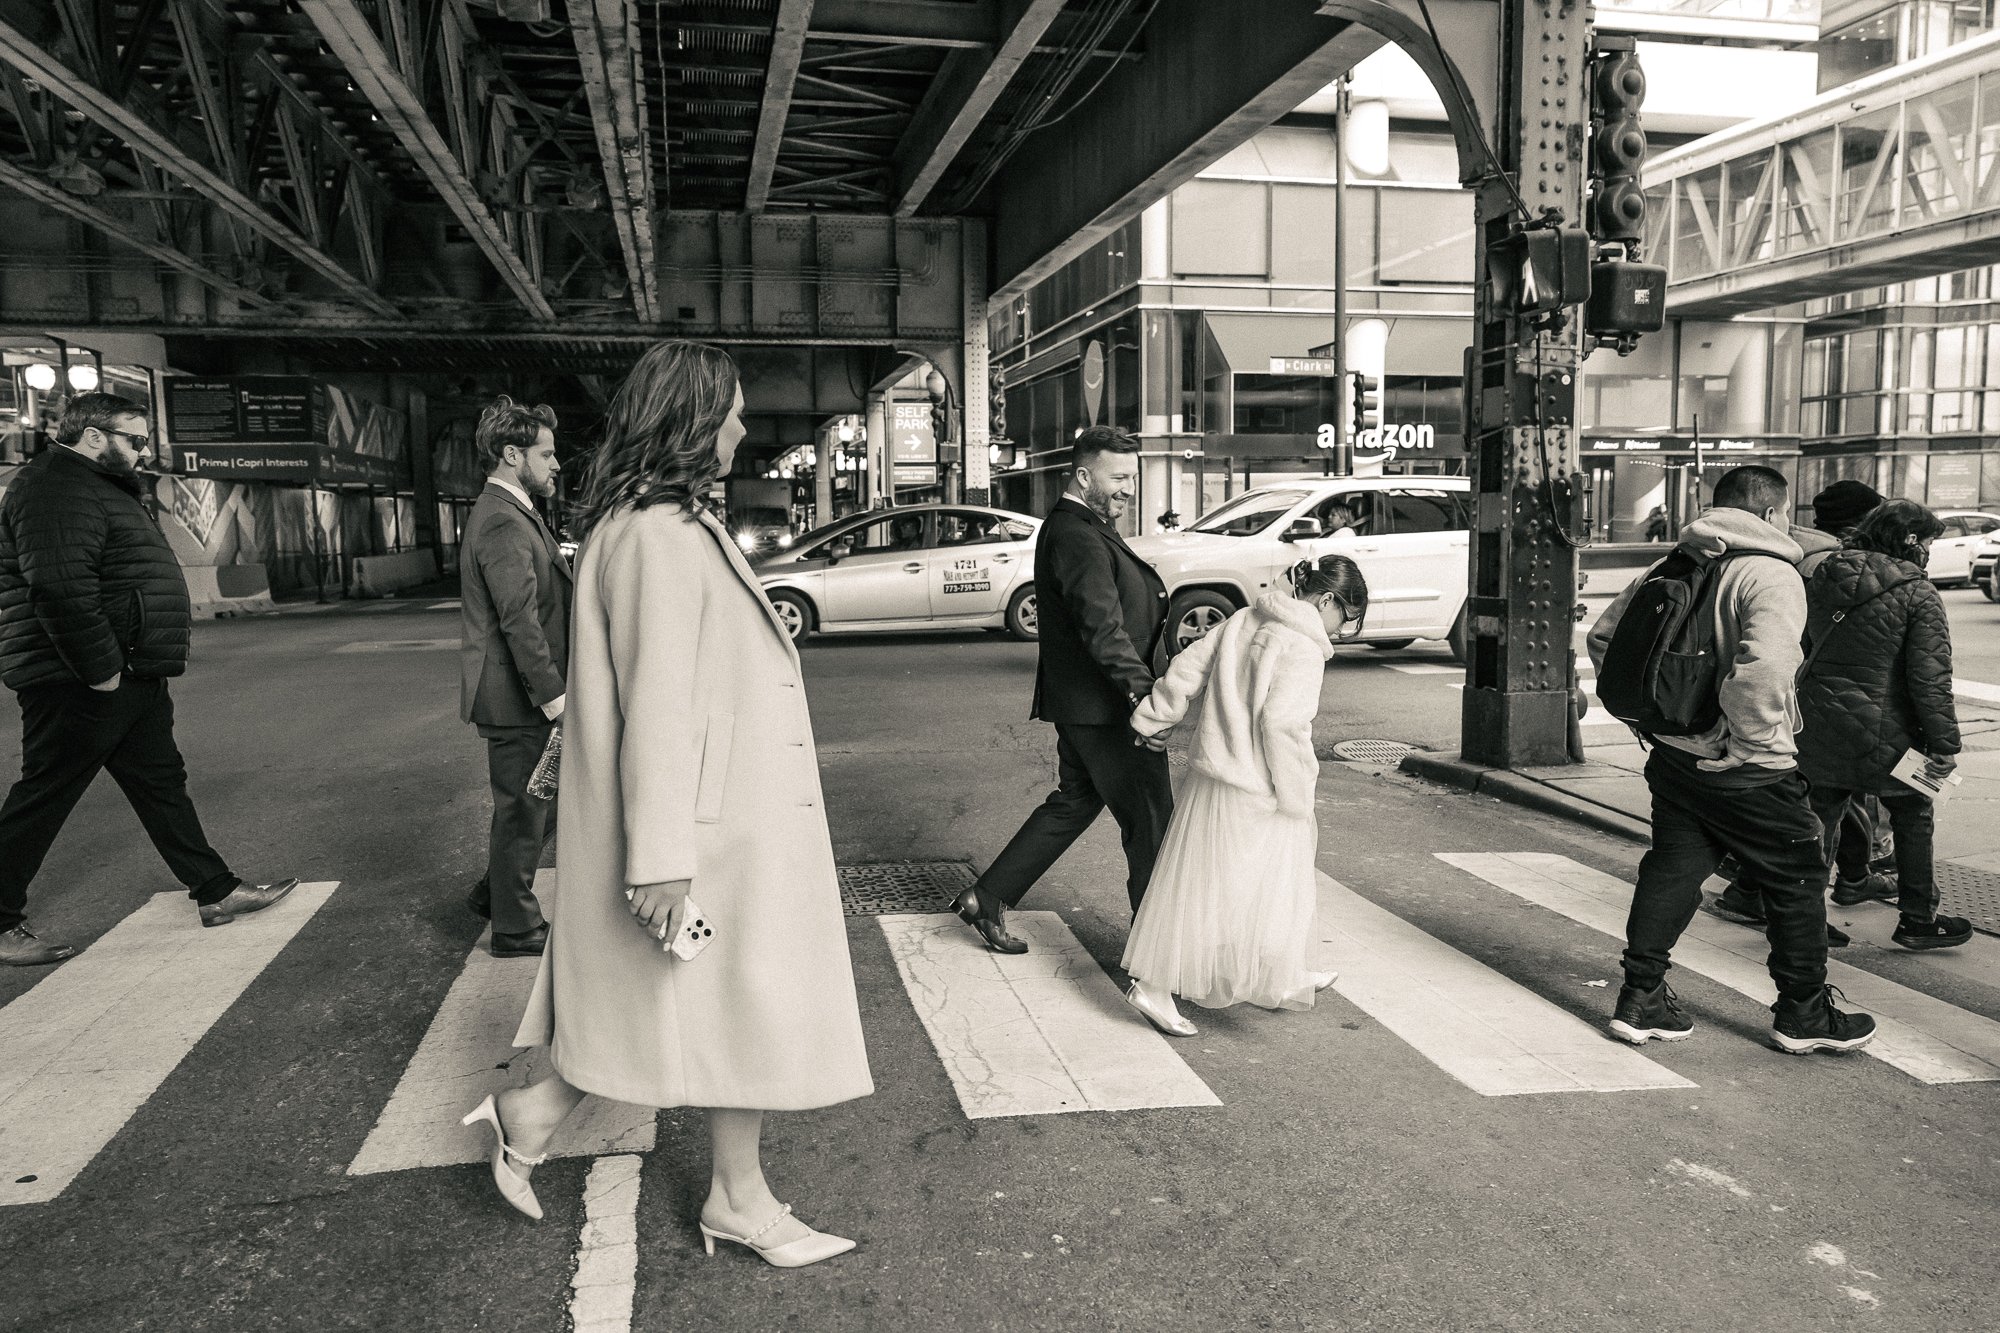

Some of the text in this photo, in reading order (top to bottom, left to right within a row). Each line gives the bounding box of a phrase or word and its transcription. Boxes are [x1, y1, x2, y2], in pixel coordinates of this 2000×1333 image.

[1293, 360, 1322, 372] Clark
[896, 406, 928, 418] SELF
[896, 419, 928, 430] PARK
[200, 458, 229, 467] Prime
[236, 458, 264, 469] Capri
[266, 458, 309, 467] Interests
[954, 560, 976, 570] 4721
